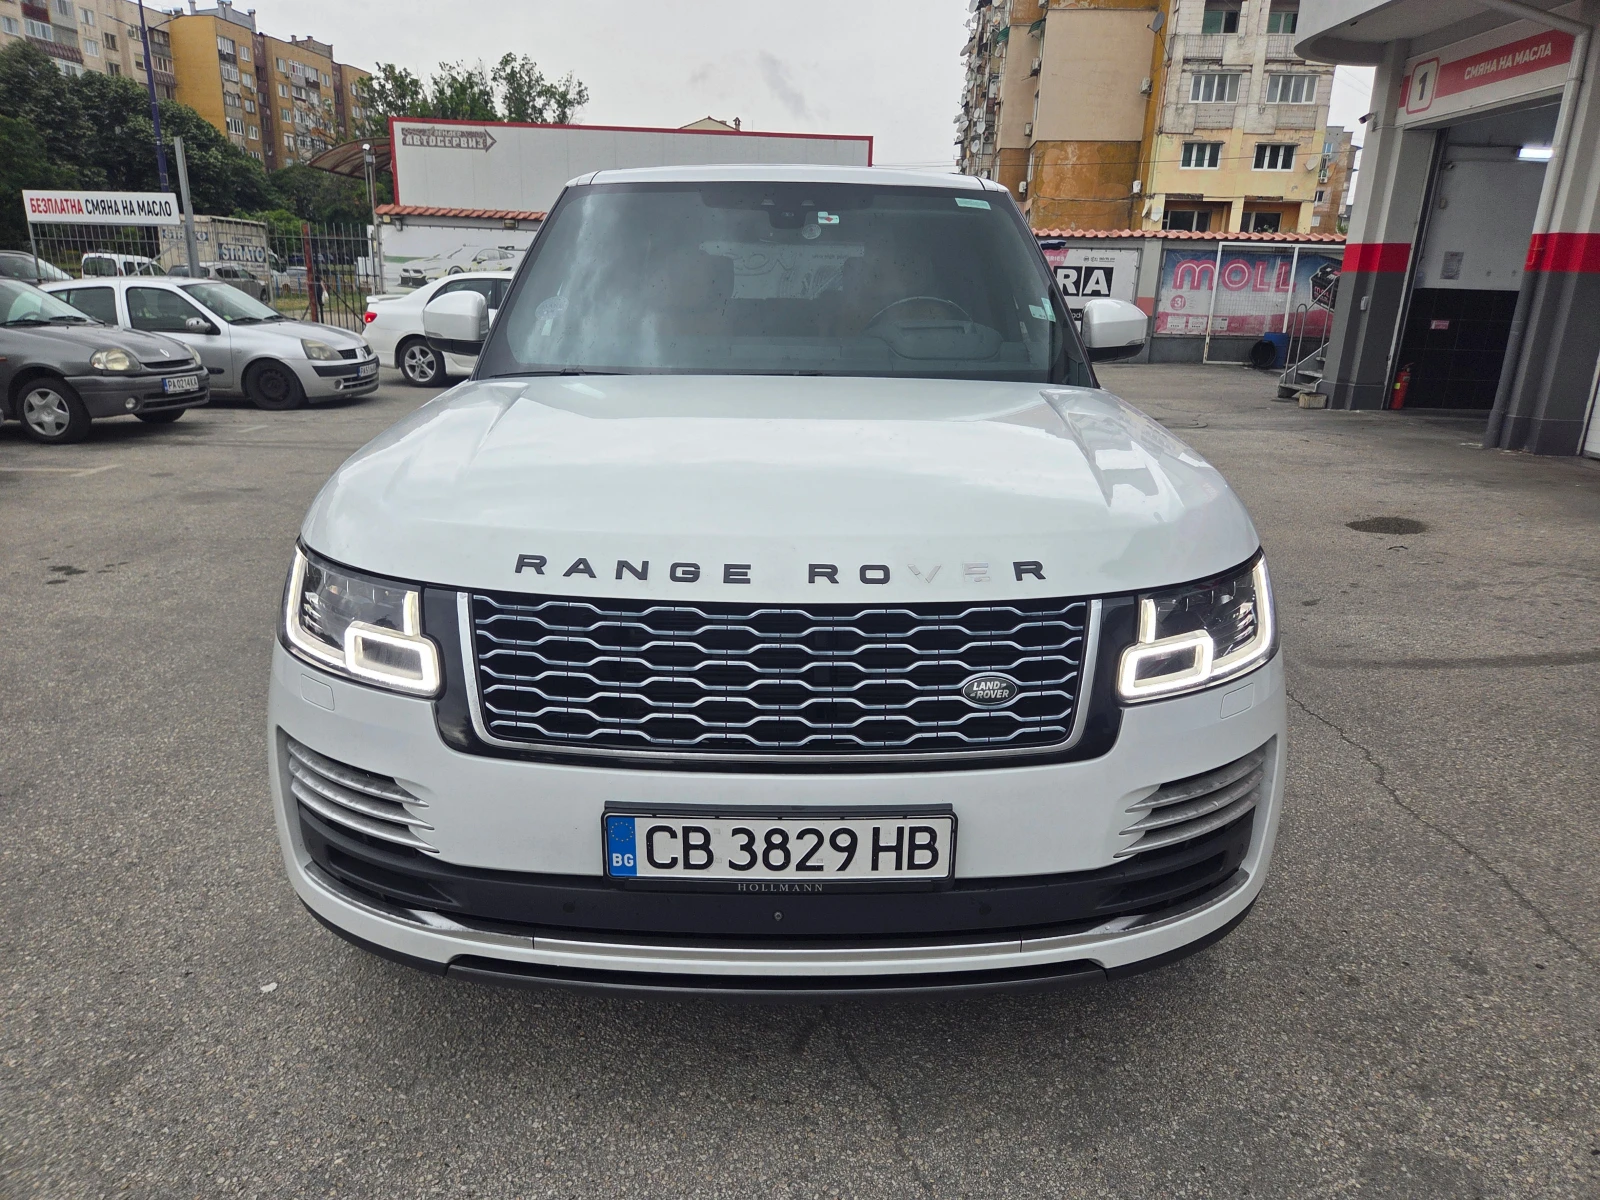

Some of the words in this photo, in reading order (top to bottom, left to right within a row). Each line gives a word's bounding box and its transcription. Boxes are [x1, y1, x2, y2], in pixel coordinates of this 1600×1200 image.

[1464, 59, 1497, 80] СМЯНА
[1498, 54, 1512, 71] НА
[1513, 42, 1552, 65] МАСЛА
[1418, 71, 1428, 101] 1
[406, 134, 484, 148] АВТОСЕРВИЗ
[29, 197, 84, 215] БЕЗПЛАТНА
[85, 198, 120, 216] СМЯНА
[122, 200, 135, 216] НА
[136, 200, 172, 217] МАСЛО
[221, 243, 265, 262] STRATO
[1172, 259, 1297, 292] MOLL
[514, 553, 752, 584] RANGE
[808, 560, 1047, 585] ROVER
[972, 681, 1000, 691] LAND
[976, 689, 1010, 699] ROVER
[645, 825, 714, 870] CB
[728, 827, 859, 871] 3829
[871, 826, 940, 871] HB
[612, 853, 634, 867] BG
[737, 883, 824, 892] HOLLMANN
